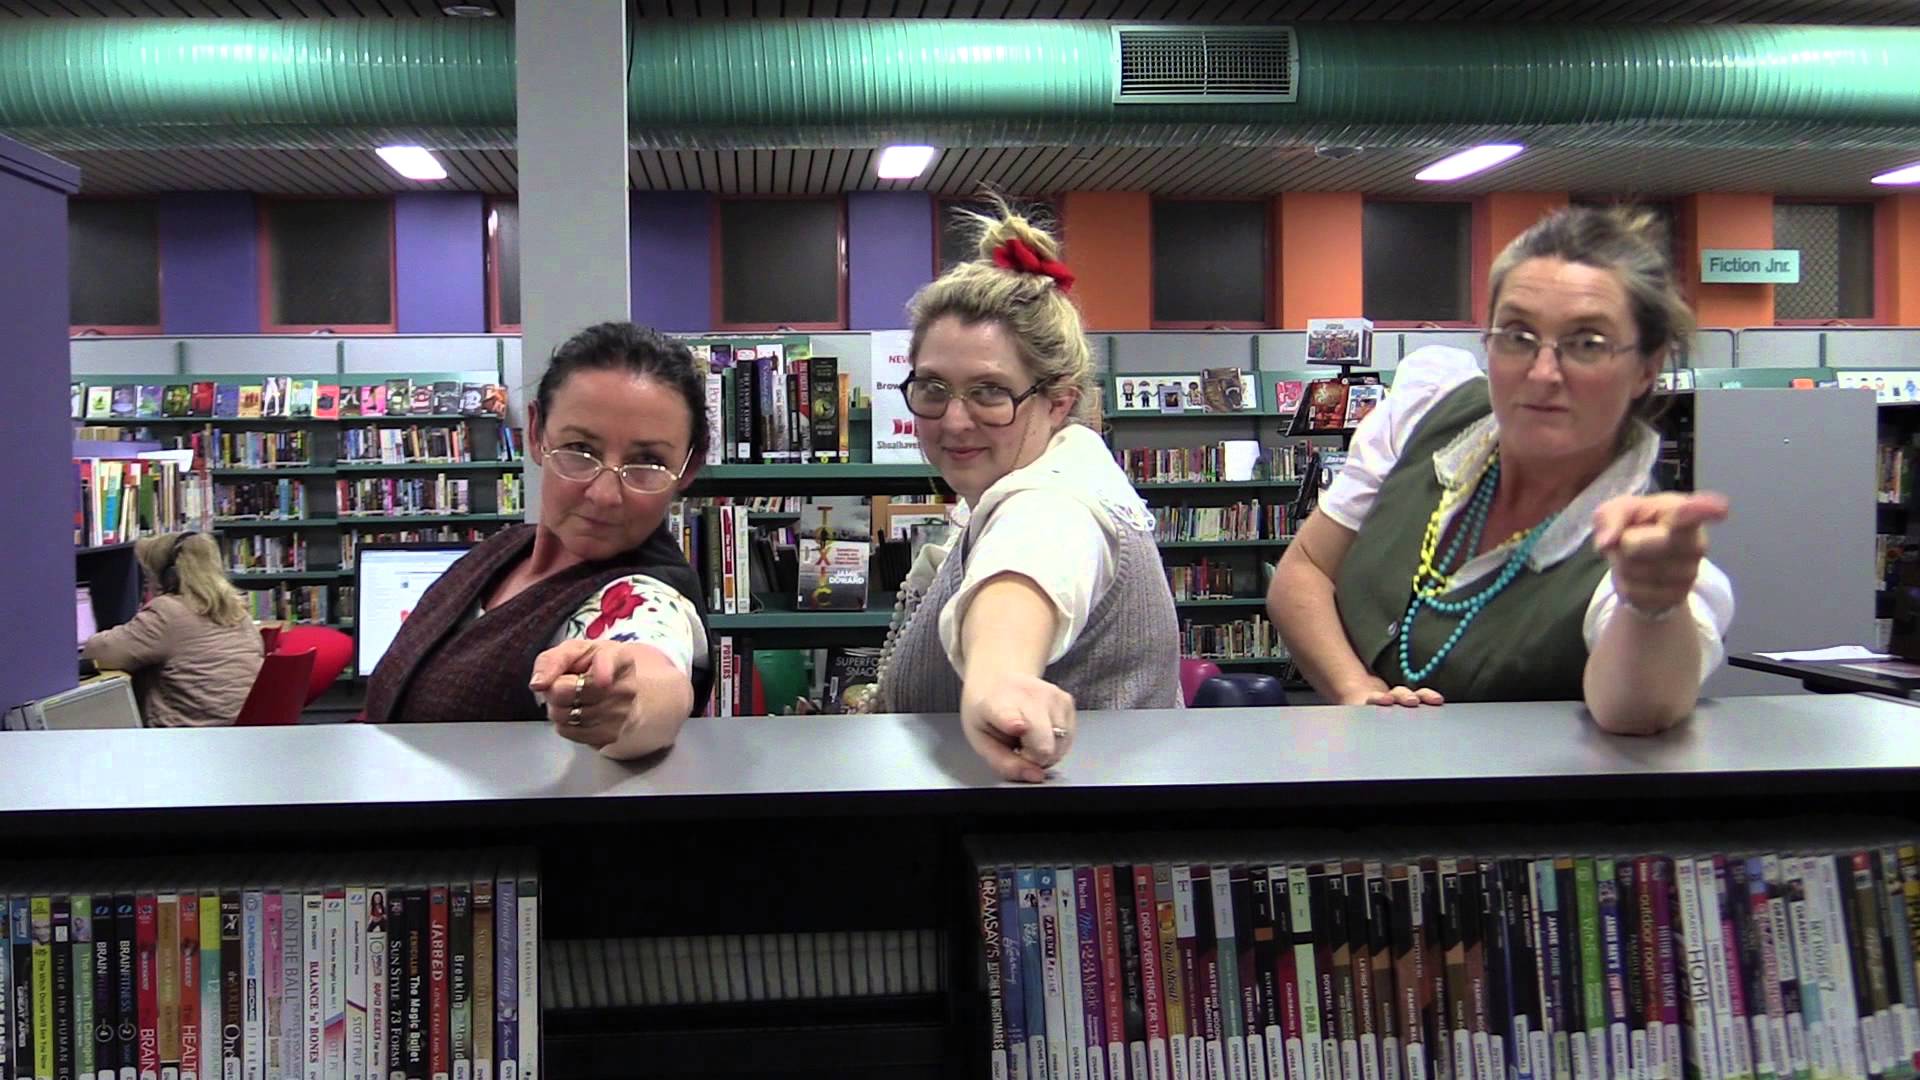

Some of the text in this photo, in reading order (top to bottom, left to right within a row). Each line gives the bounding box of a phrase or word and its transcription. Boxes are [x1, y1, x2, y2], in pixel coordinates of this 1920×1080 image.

[1710, 257, 1761, 273] Fiction
[722, 644, 732, 680] POSTERS
[1140, 912, 1152, 940] DROP
[1546, 916, 1560, 945] JAMIE
[1639, 894, 1656, 981] outdoor room
[285, 908, 299, 1004] ON THE BALL
[391, 941, 401, 966] SUN
[431, 920, 444, 981] JABBED
[310, 961, 319, 1009] BALANCE
[391, 967, 402, 1000] STYLE
[410, 976, 420, 994] The
[981, 887, 1006, 1050] RAMSAY'S KITCHEN NIGHTMARES
[1141, 941, 1155, 1001] EVERYTHING
[1207, 962, 1218, 1009] MASTERING
[1264, 971, 1273, 998] RUSTIC
[1358, 958, 1368, 986] LAYING
[373, 982, 382, 1006] RAPID
[454, 955, 466, 1059] Breaking Mould
[1244, 986, 1254, 1020] TURNING
[1322, 974, 1333, 1012] DOVETAIL
[1406, 988, 1416, 1024] FRAMING
[1435, 977, 1444, 1014] FRAMING
[1473, 978, 1483, 1014] FRAMING
[1663, 973, 1676, 1007] DESIGN
[374, 1008, 382, 1040] RESULTS
[391, 1010, 402, 1024] 73
[409, 998, 420, 1029] Magic
[1146, 1002, 1157, 1020] FOR
[1203, 996, 1214, 1039] MACHINES
[58, 1018, 68, 1061] HUMAN
[310, 1027, 320, 1064] BONES
[353, 1016, 362, 1045] STOTT
[391, 1028, 402, 1067] FORMS
[410, 1031, 421, 1063] Bullet
